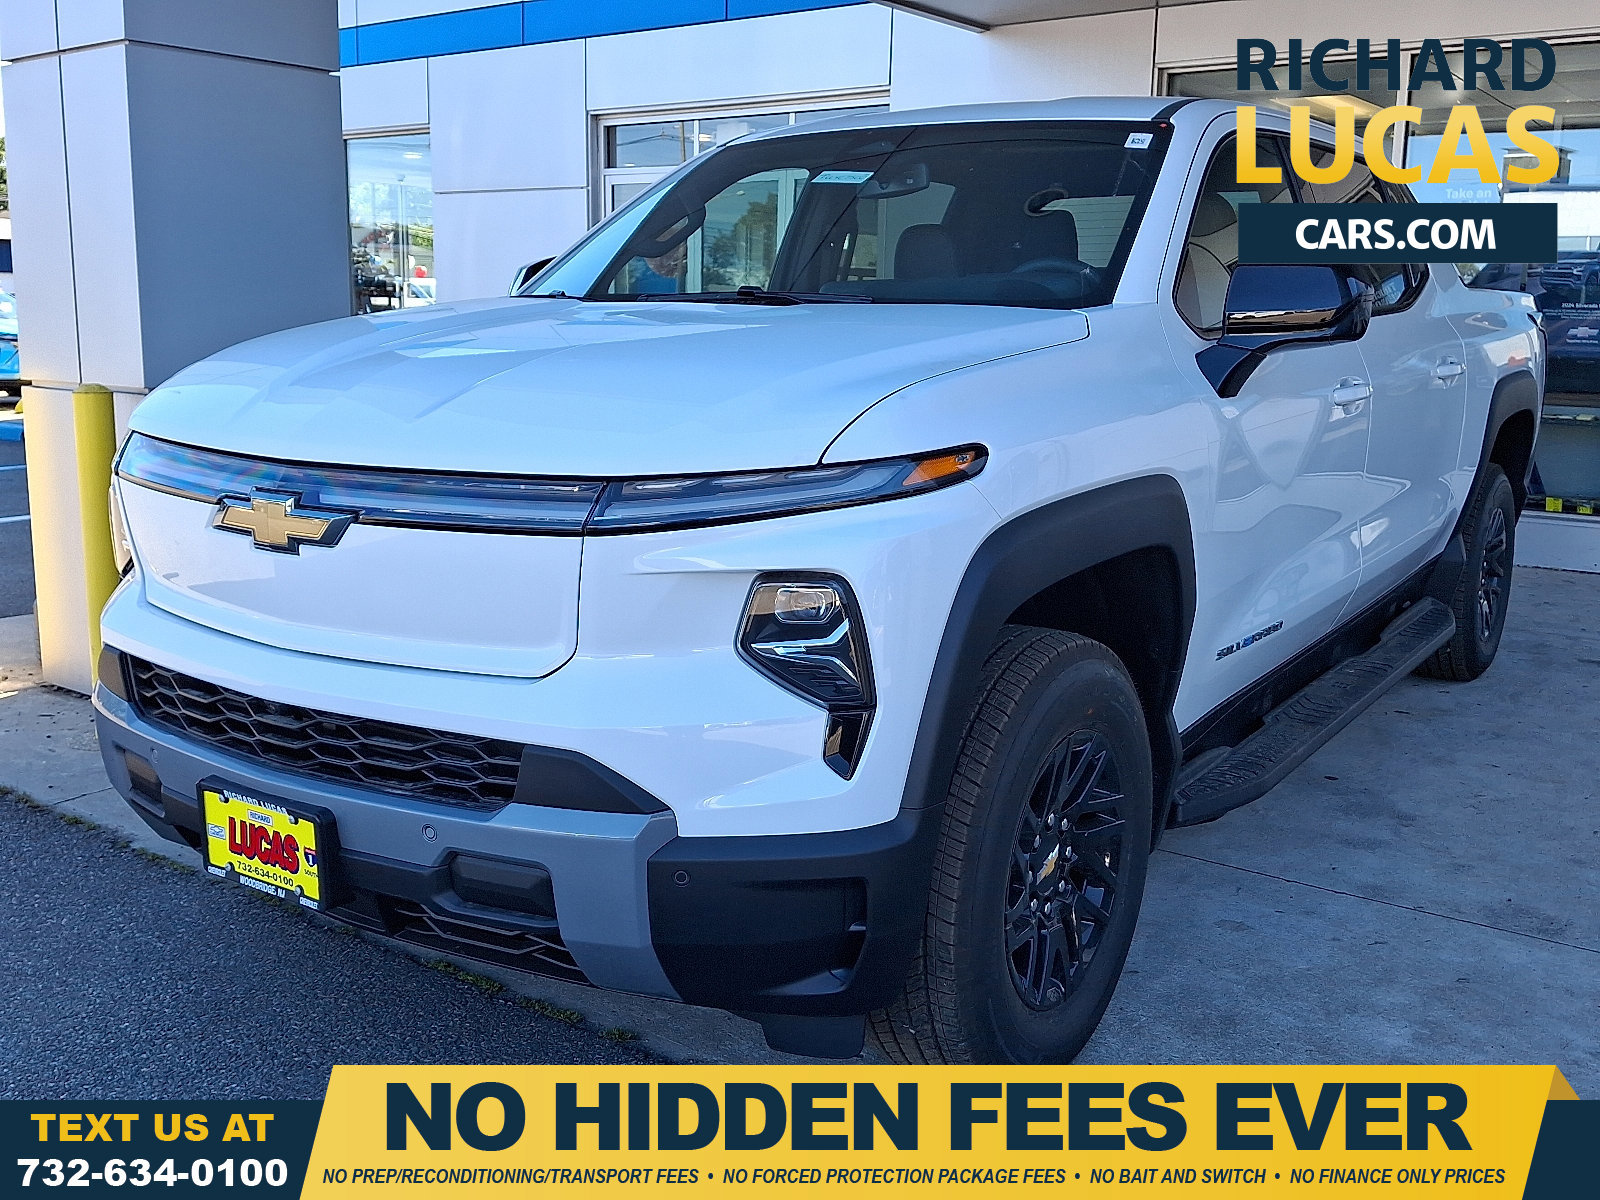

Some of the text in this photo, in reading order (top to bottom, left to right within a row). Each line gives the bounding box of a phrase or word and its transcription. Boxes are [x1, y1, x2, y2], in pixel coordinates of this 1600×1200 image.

[1445, 188, 1474, 199] Take
[223, 789, 288, 815] RICHARD LUCAS
[249, 811, 271, 824] RICHARD
[228, 815, 300, 874] LUCAS
[236, 860, 294, 887] 732-634-0100
